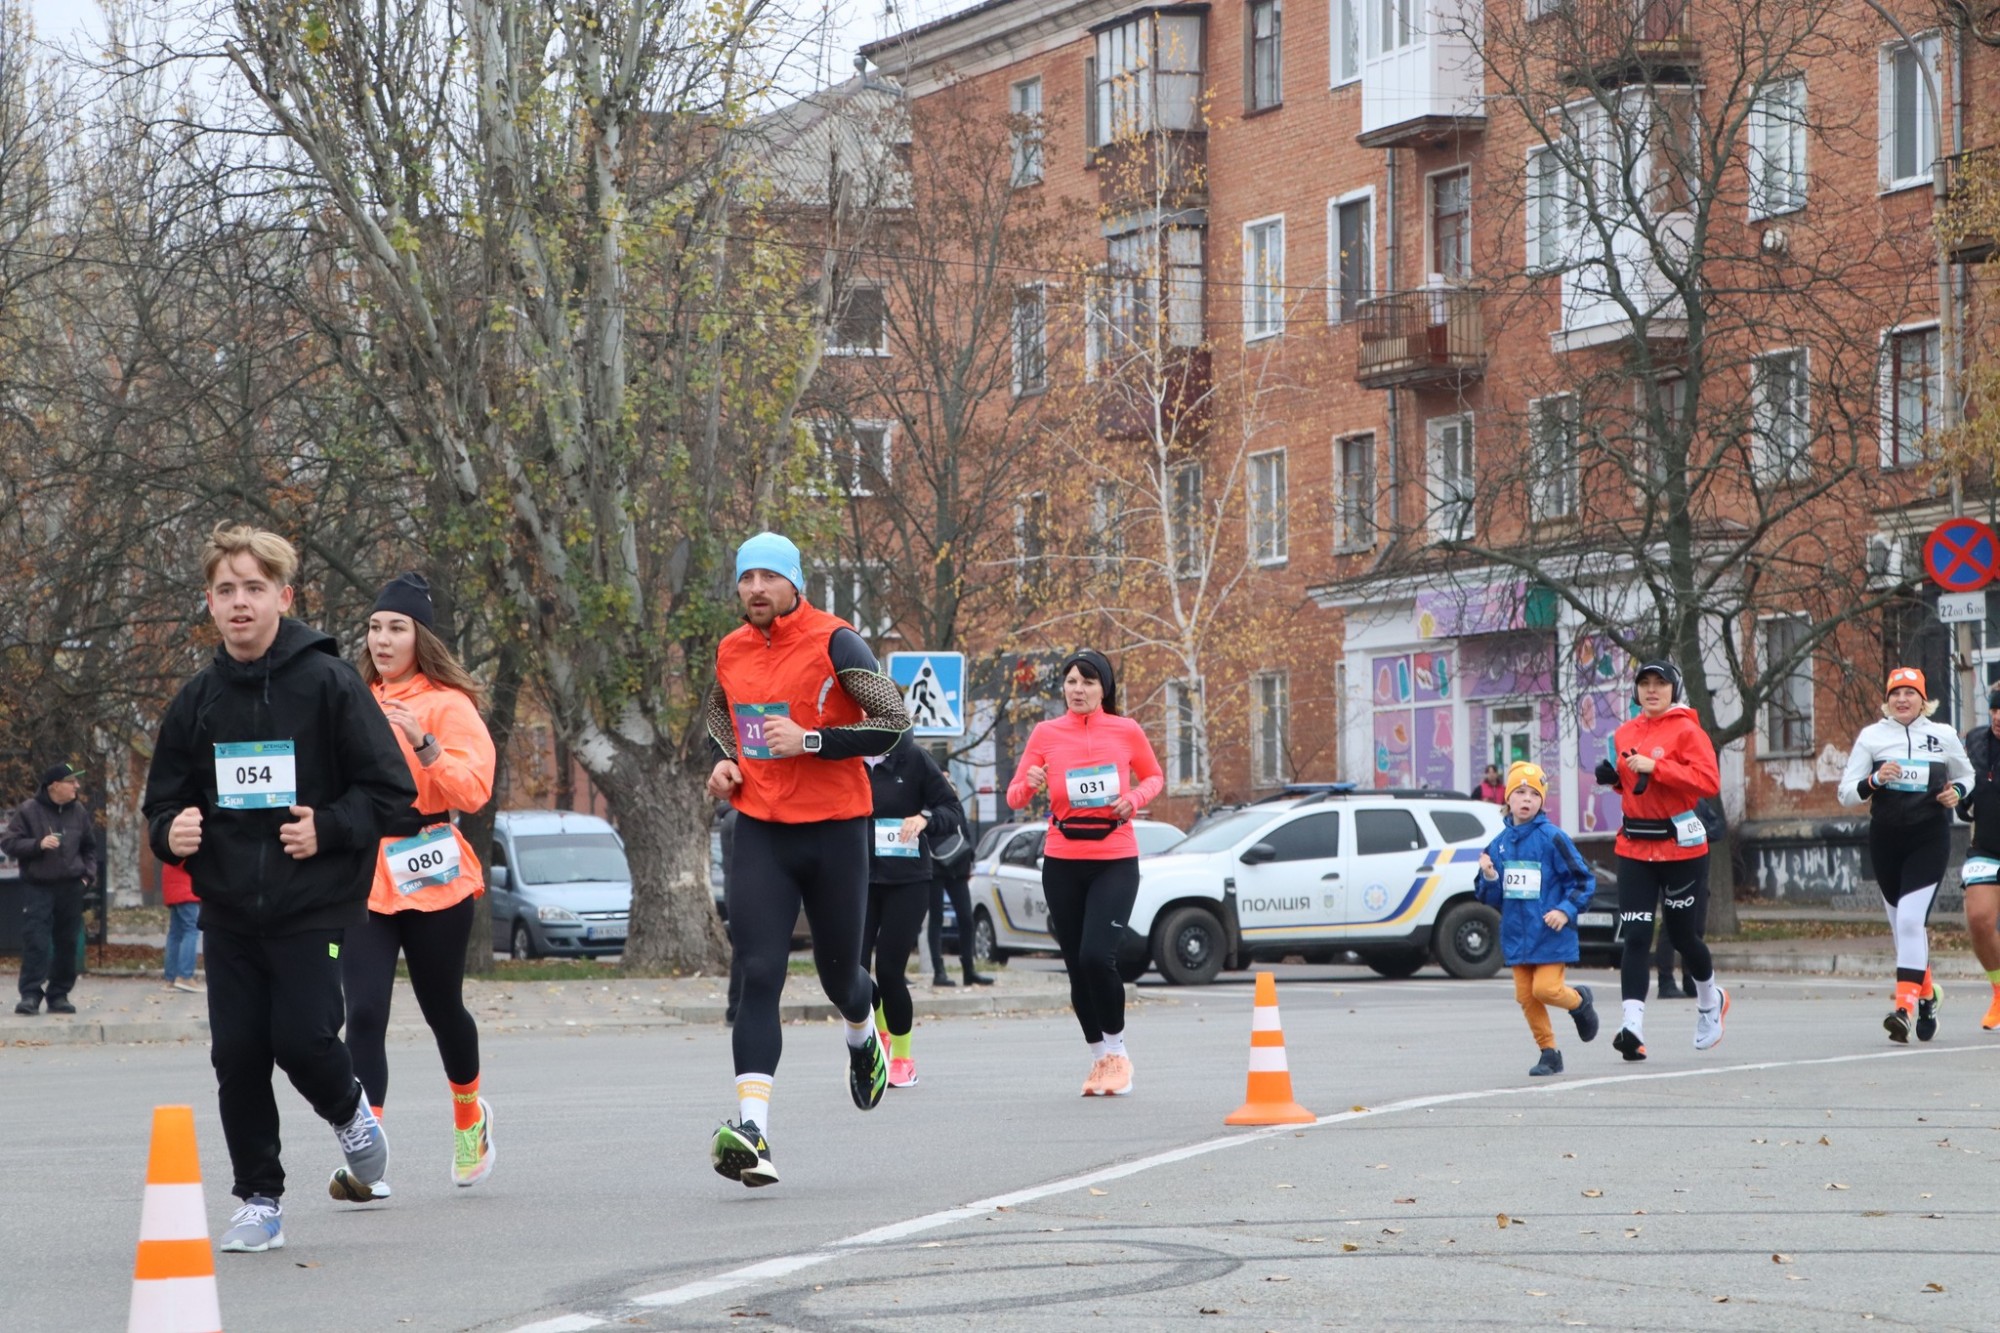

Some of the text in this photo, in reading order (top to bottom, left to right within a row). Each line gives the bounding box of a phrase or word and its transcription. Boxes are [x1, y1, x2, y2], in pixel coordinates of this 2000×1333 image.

[236, 766, 272, 784] 054
[1080, 780, 1105, 794] 031
[408, 850, 444, 873] 080
[1506, 874, 1527, 885] 021
[1242, 896, 1311, 912] ПОЛІЦІЯ
[1664, 895, 1695, 909] PRO
[1620, 911, 1653, 921] NIKE
